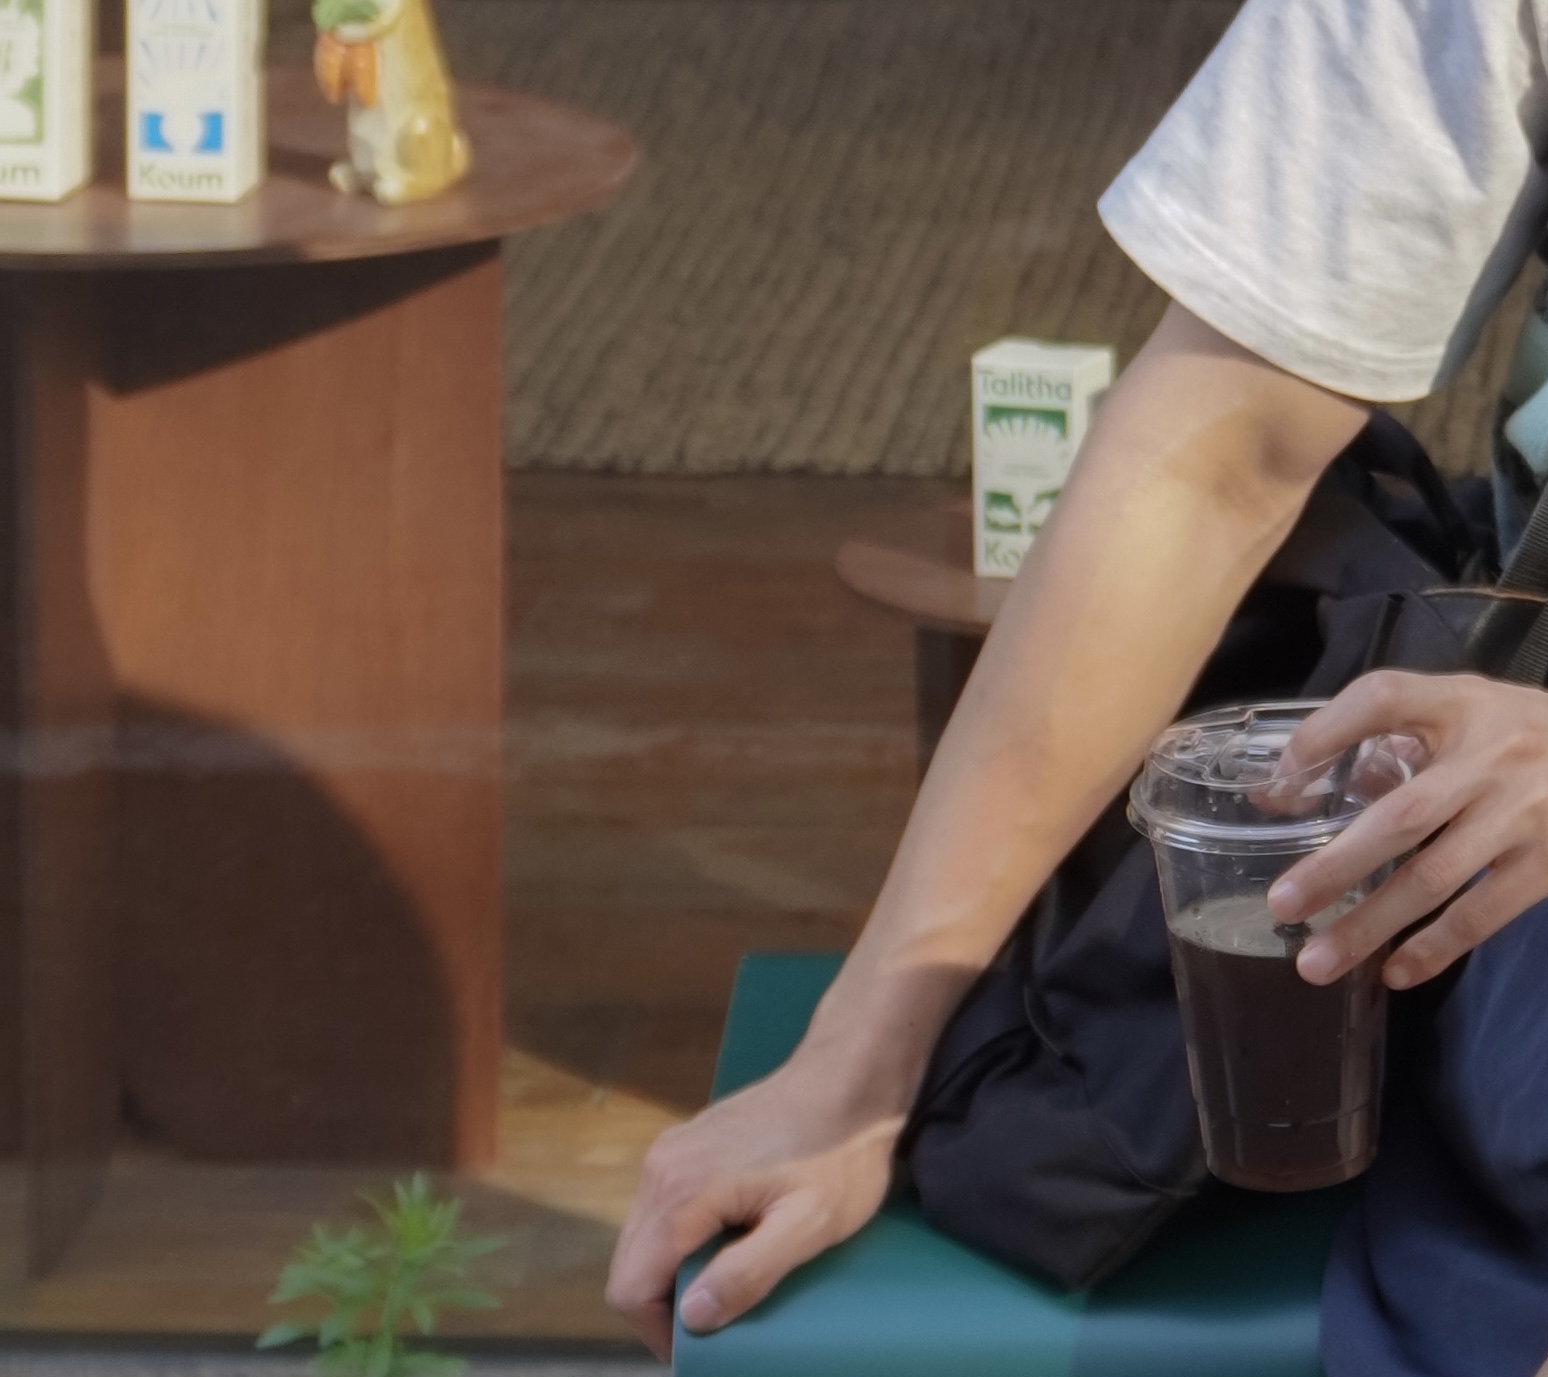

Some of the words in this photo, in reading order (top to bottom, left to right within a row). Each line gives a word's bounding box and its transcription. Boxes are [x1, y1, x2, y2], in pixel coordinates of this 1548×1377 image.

[139, 162, 223, 190] Koum
[977, 370, 1072, 401] Talitha
[984, 539, 1021, 569] Ko
